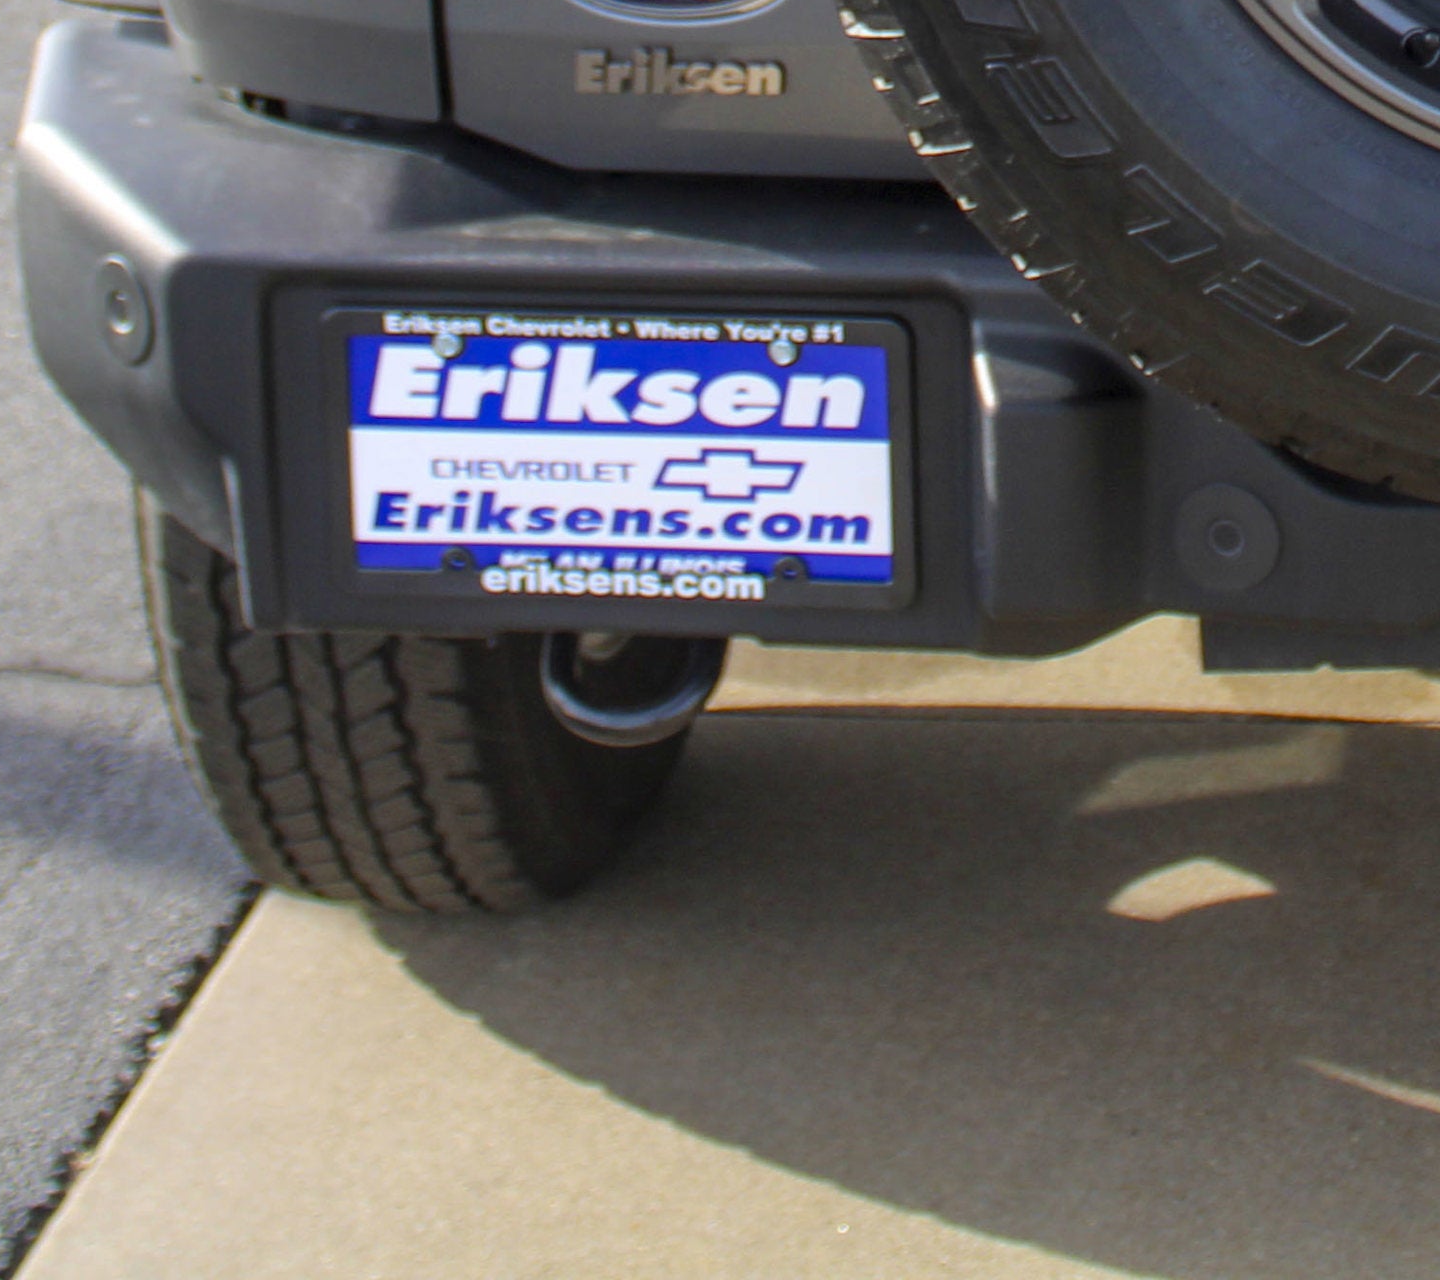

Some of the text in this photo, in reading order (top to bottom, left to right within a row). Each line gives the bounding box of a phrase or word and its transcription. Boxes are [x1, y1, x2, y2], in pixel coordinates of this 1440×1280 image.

[573, 46, 786, 97] Eriksen
[382, 311, 845, 343] Eriksen Chevrolet Where You're #1
[368, 342, 865, 430] Eriksen
[430, 457, 636, 483] CHEVROLET
[372, 489, 871, 545] Eriksens.com
[480, 562, 765, 601] eriksens.com
